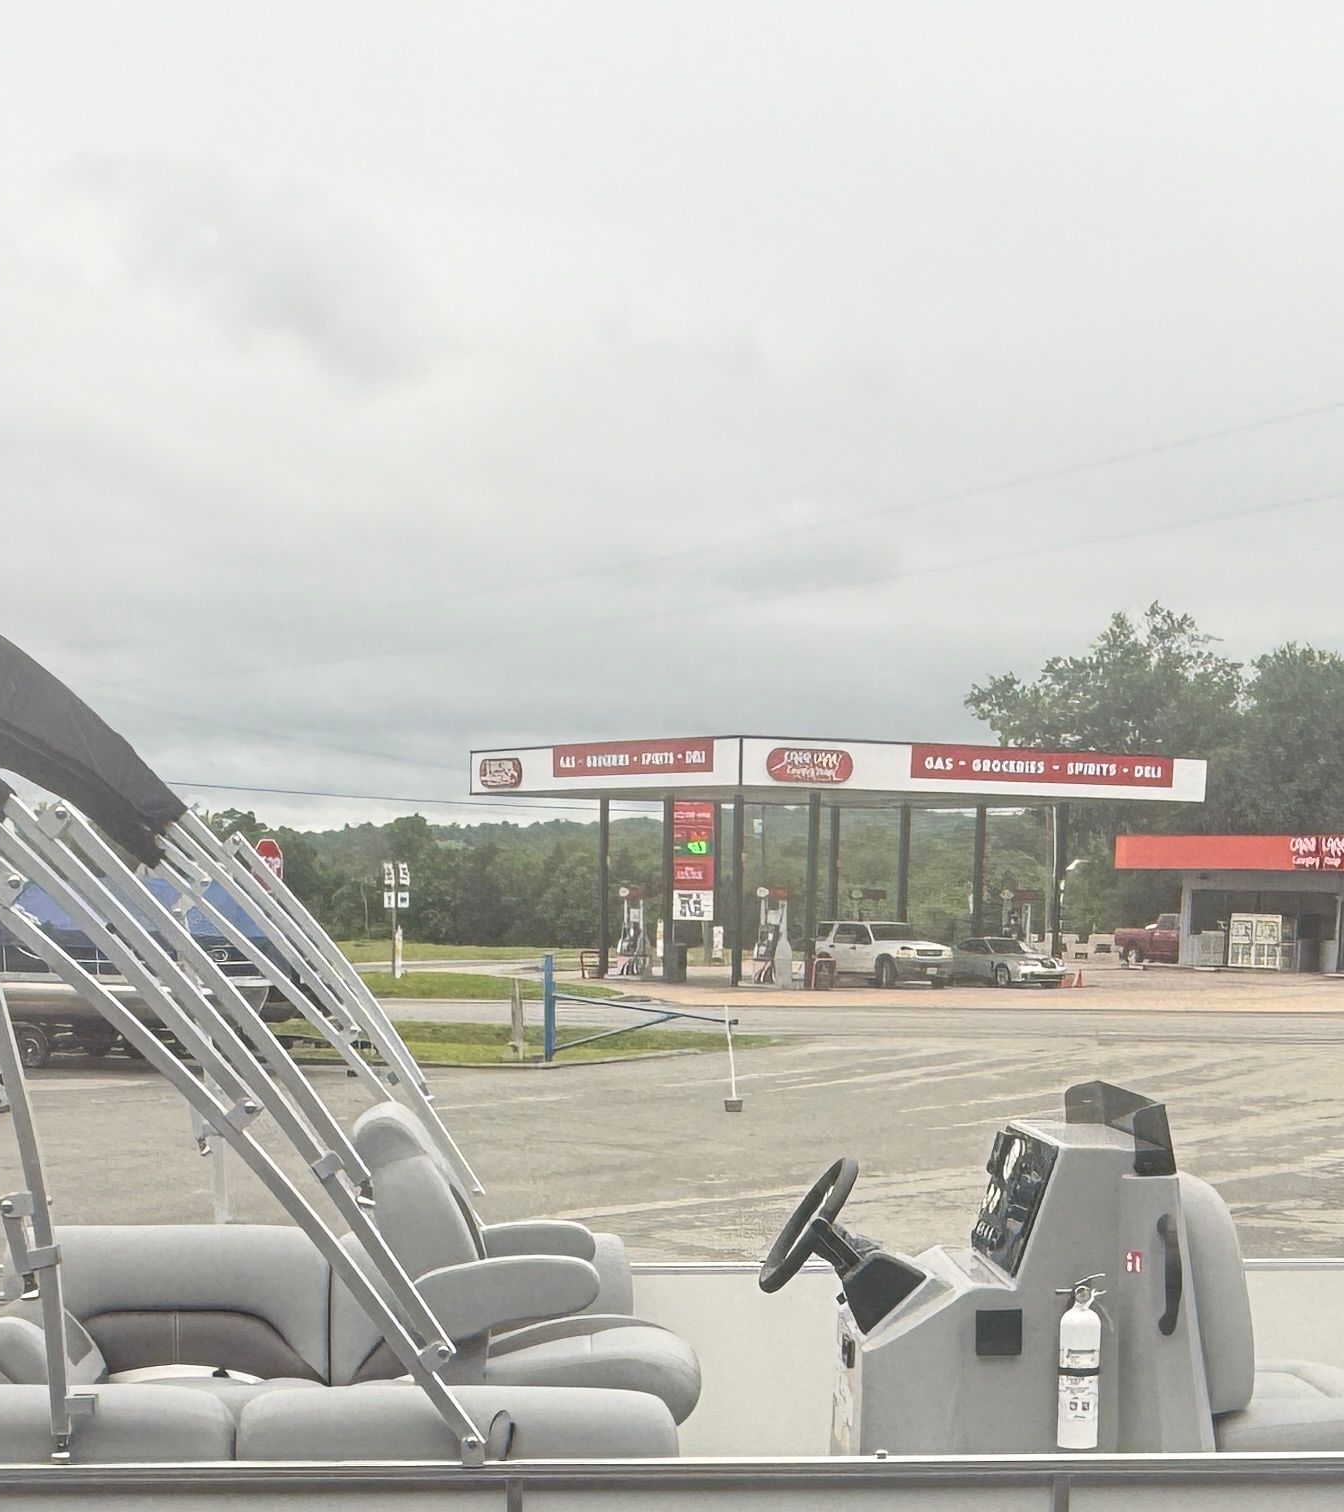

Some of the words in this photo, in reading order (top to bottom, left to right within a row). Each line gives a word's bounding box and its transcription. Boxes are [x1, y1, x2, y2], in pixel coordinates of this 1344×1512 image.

[924, 756, 954, 771] GAS
[971, 758, 1045, 775] GROCERIES
[1066, 761, 1117, 777] SPIRITS
[1133, 765, 1162, 779] DELI
